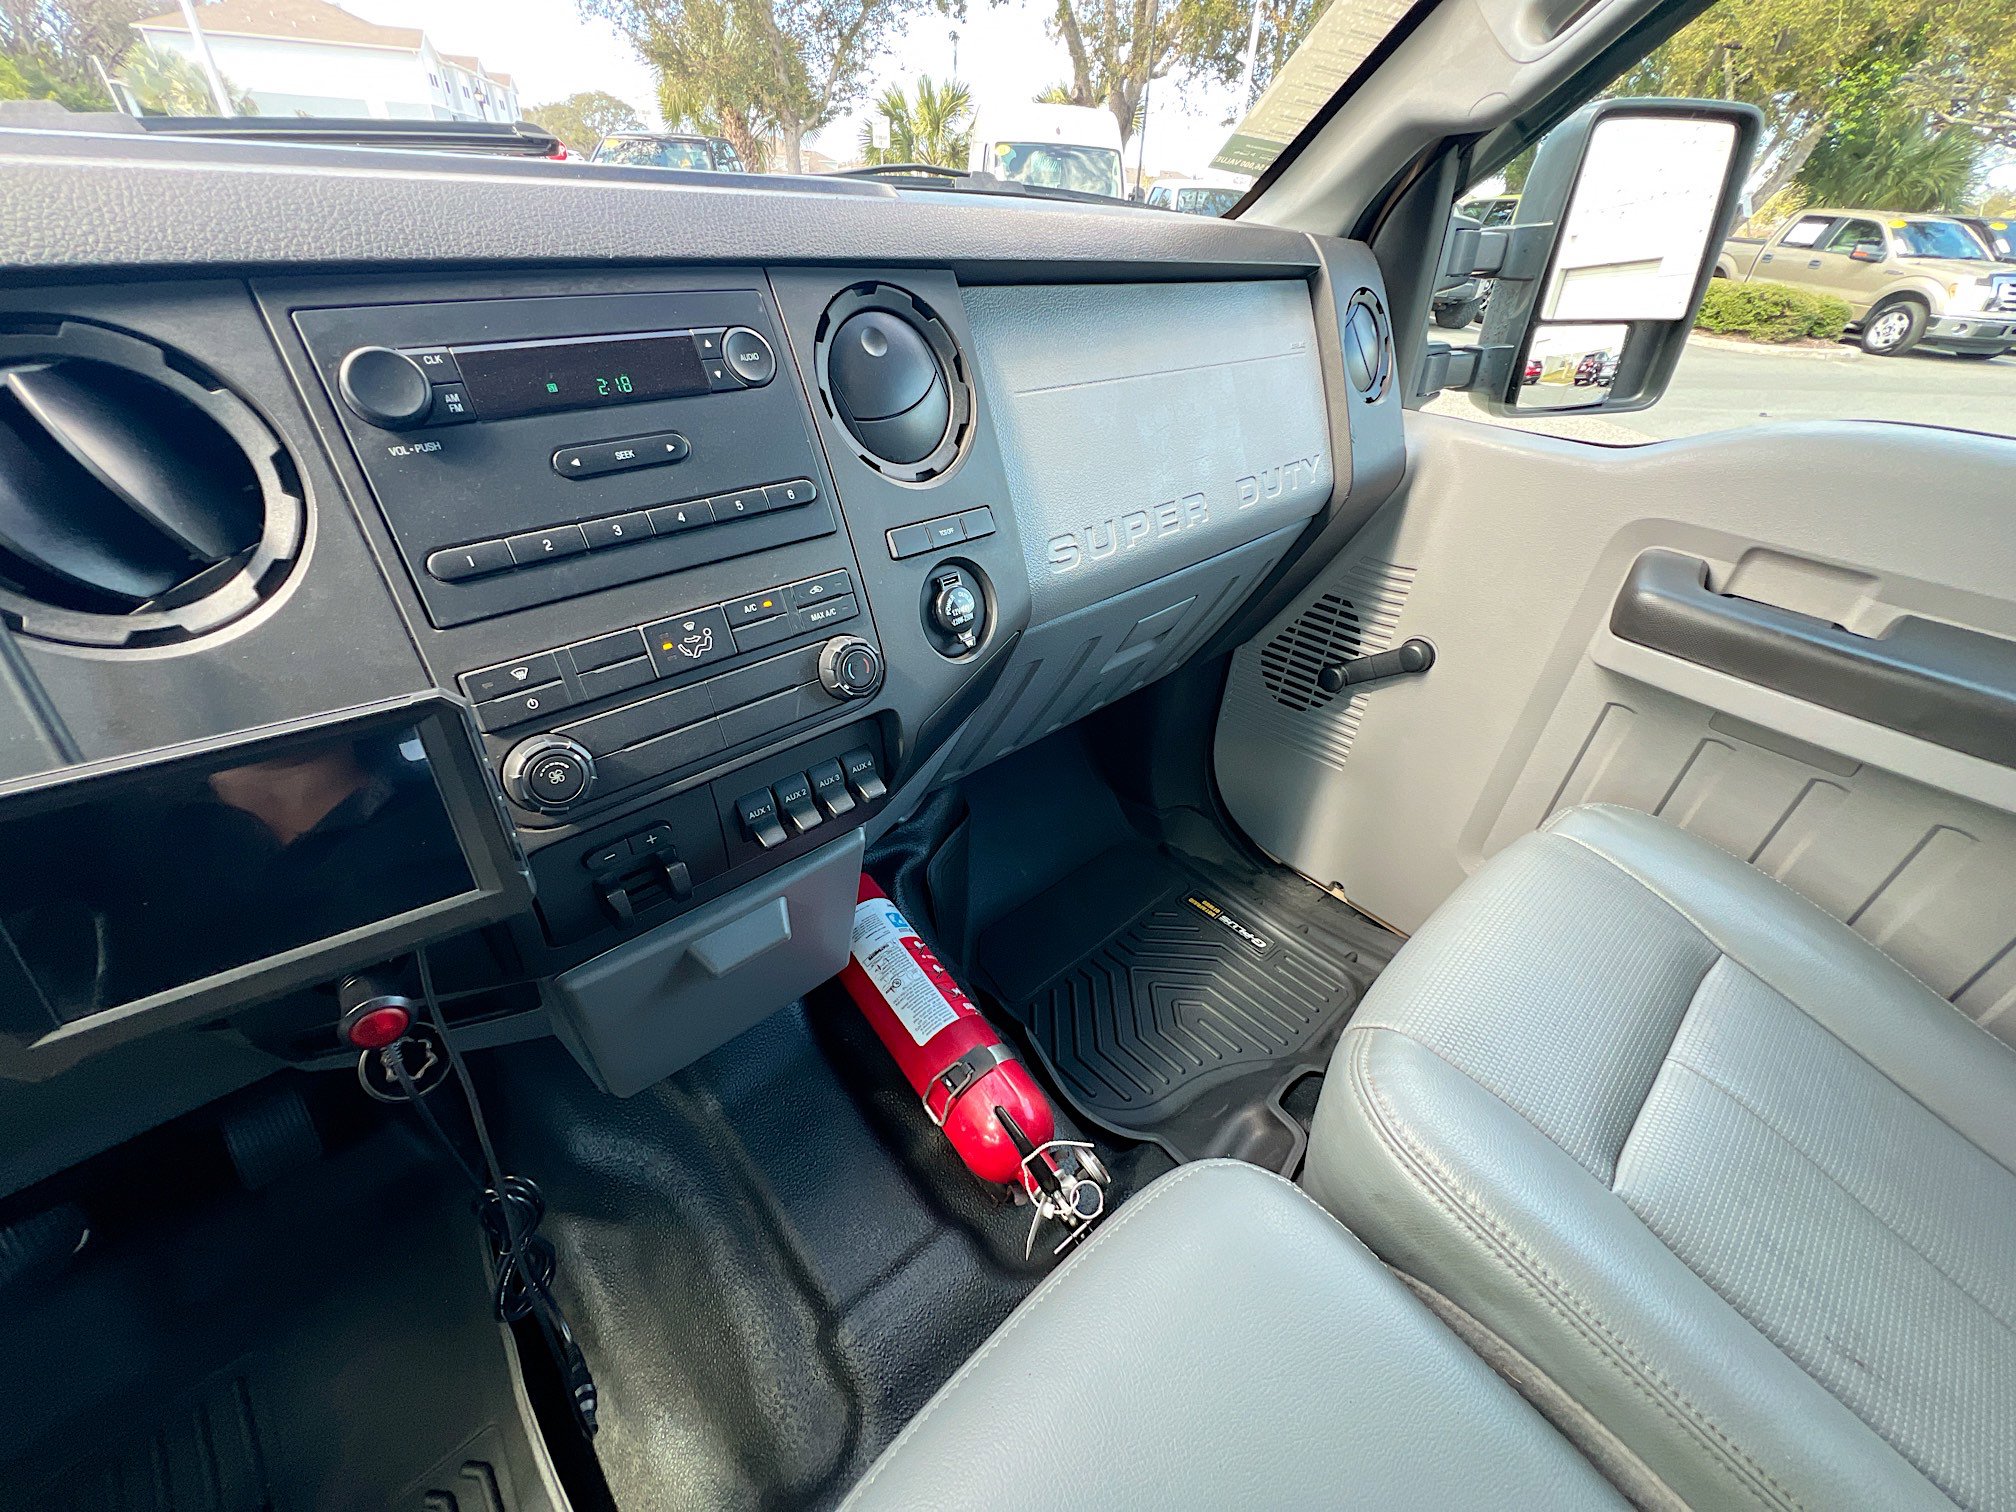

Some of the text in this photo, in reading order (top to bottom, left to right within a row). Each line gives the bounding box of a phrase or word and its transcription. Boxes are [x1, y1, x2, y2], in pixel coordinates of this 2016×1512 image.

[422, 355, 444, 365] CLK
[740, 352, 760, 362] AUDIO
[596, 373, 633, 396] 2:18
[445, 393, 460, 404] AM
[448, 403, 465, 413] FM
[614, 449, 636, 461] SEEK
[1049, 453, 1321, 575] SUPER DUTY
[466, 489, 796, 568] 1 2 3 4 5 6
[743, 603, 758, 614] A/C
[810, 608, 837, 622] MAX A/C
[852, 760, 872, 774] AUX 4
[819, 774, 841, 788] AUX 3
[785, 788, 807, 803] AUX 2
[749, 806, 767, 820] AUX
